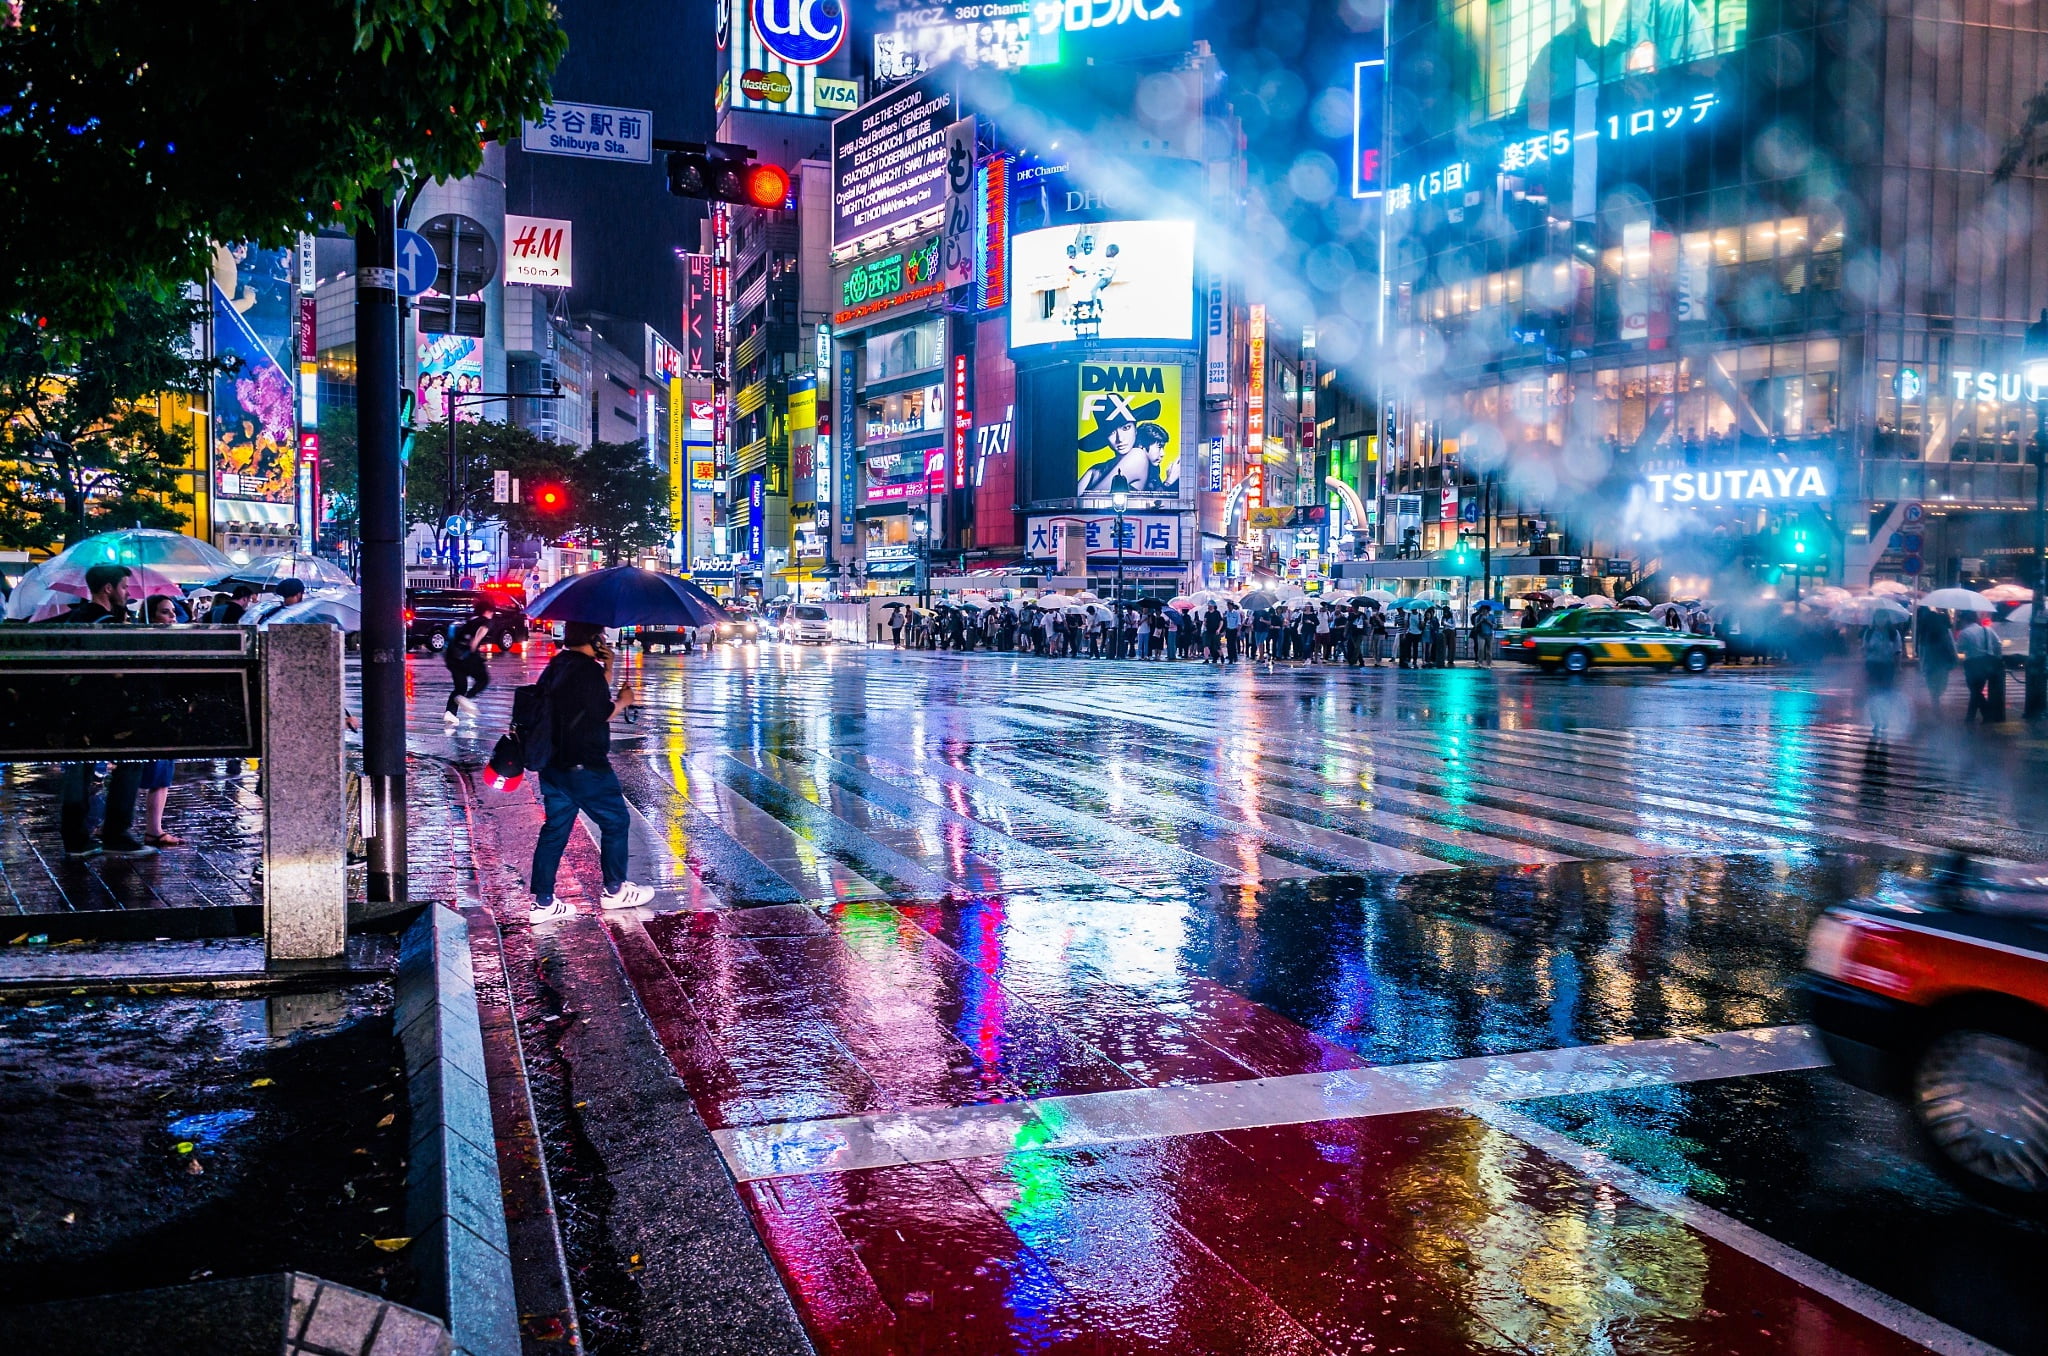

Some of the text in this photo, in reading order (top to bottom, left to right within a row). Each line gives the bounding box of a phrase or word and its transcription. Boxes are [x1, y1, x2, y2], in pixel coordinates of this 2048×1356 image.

[741, 78, 791, 93] MasterCard
[819, 85, 857, 103] VISA
[533, 107, 642, 140] 渋谷駅前
[859, 132, 871, 148] Soul
[871, 121, 898, 140] Brothers
[901, 93, 951, 127] GENERATIONS
[863, 91, 922, 132] EXILE THE SECOND
[549, 134, 629, 154] Shibuya Sta.
[854, 149, 872, 166] EXILE
[905, 156, 924, 175] SWAY
[1017, 161, 1070, 182] DHC Channel
[842, 198, 866, 218] MIGHTY
[948, 138, 973, 280] もんじゃ
[512, 225, 564, 261] H&M
[518, 266, 548, 277] 150m
[1081, 365, 1165, 394] DMM
[1081, 393, 1137, 422] FX
[842, 375, 853, 472] サマーフルーツギフト
[869, 416, 921, 439] Euphoria
[1649, 466, 1827, 503] TSUTAYA
